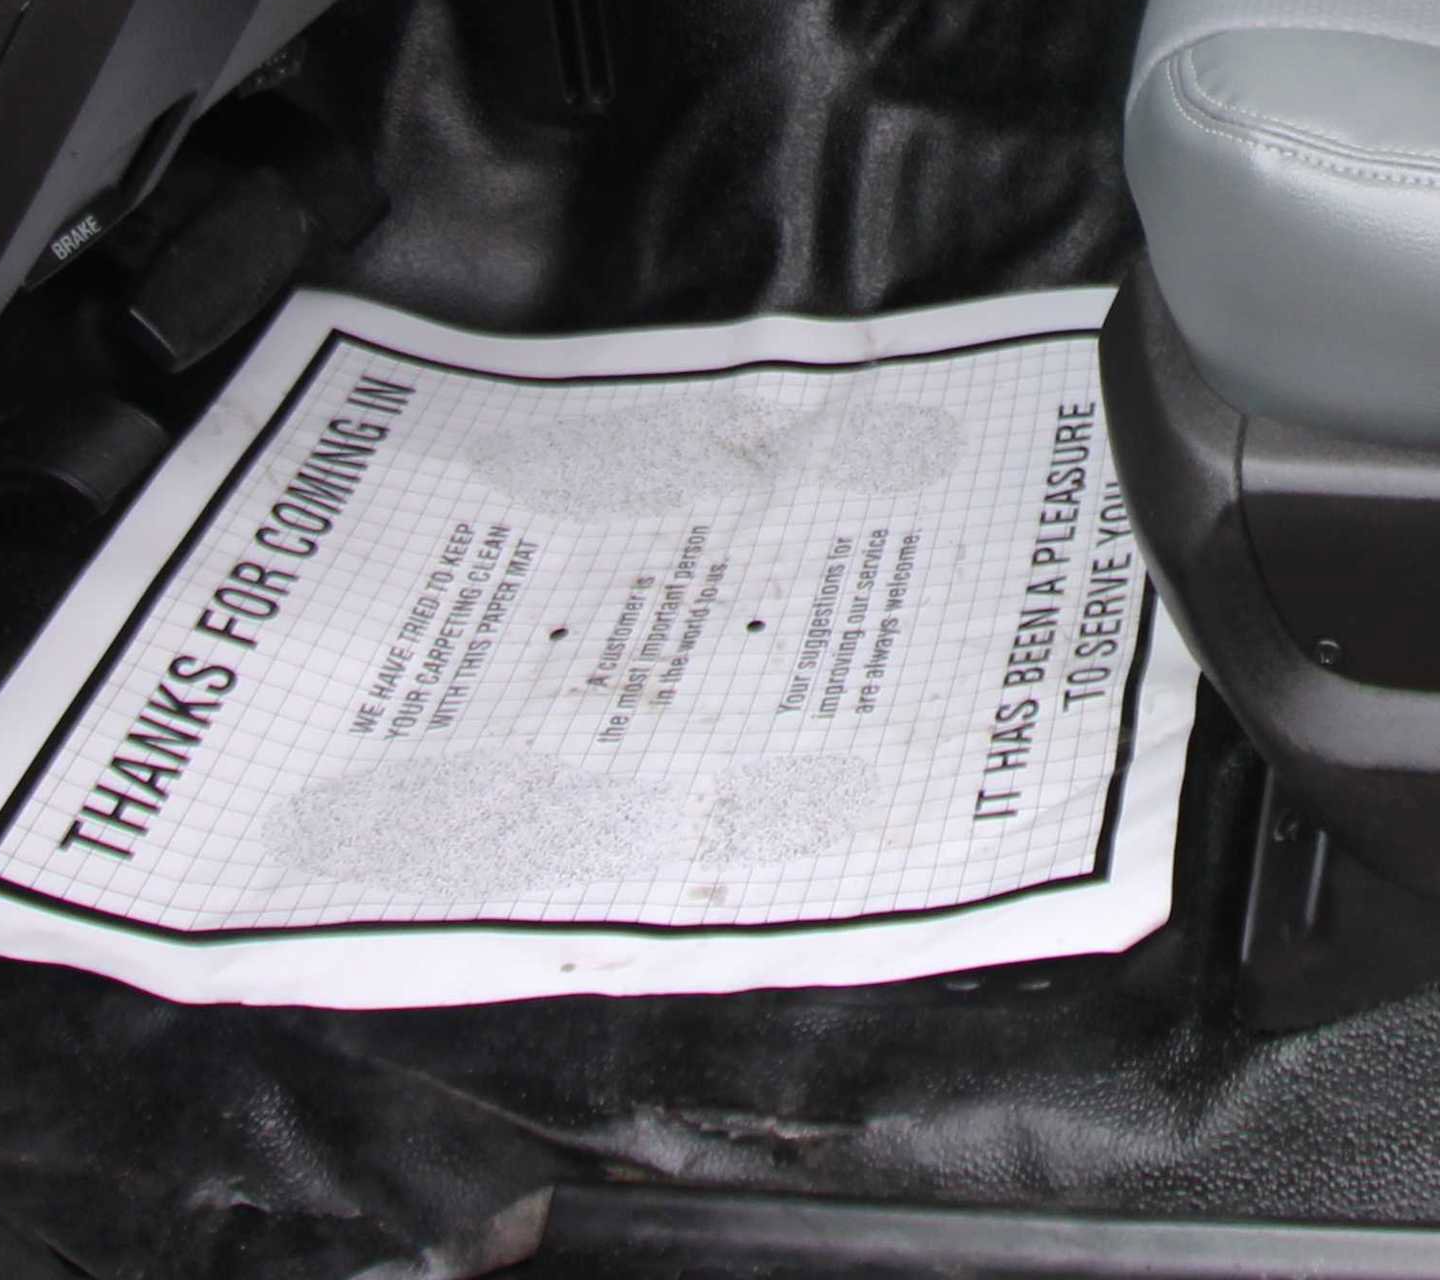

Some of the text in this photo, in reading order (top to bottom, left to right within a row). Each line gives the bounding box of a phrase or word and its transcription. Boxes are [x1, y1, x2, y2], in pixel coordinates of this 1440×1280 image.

[51, 215, 103, 260] BRAKE
[58, 375, 417, 861] THANKS FOR COMING IN
[349, 523, 476, 734] WE HAVE TRIED TO KEEP
[384, 525, 511, 741] YOUR CARPETING CLEAN
[428, 537, 540, 731] WITH THIS PAPER MAT
[586, 575, 656, 688] A customer is
[596, 525, 710, 743] the most important person
[678, 608, 710, 652] world
[694, 587, 719, 606] to
[706, 557, 730, 582] us.
[776, 536, 854, 715] Your suggestions for
[812, 528, 889, 720] improving our service
[855, 527, 923, 715] are always welcome.
[973, 400, 1097, 822] IT HAS BEEN A PLEASURE
[1076, 552, 1132, 658] SERVE
[658, 655, 689, 683] the
[1062, 665, 1107, 712] TO
